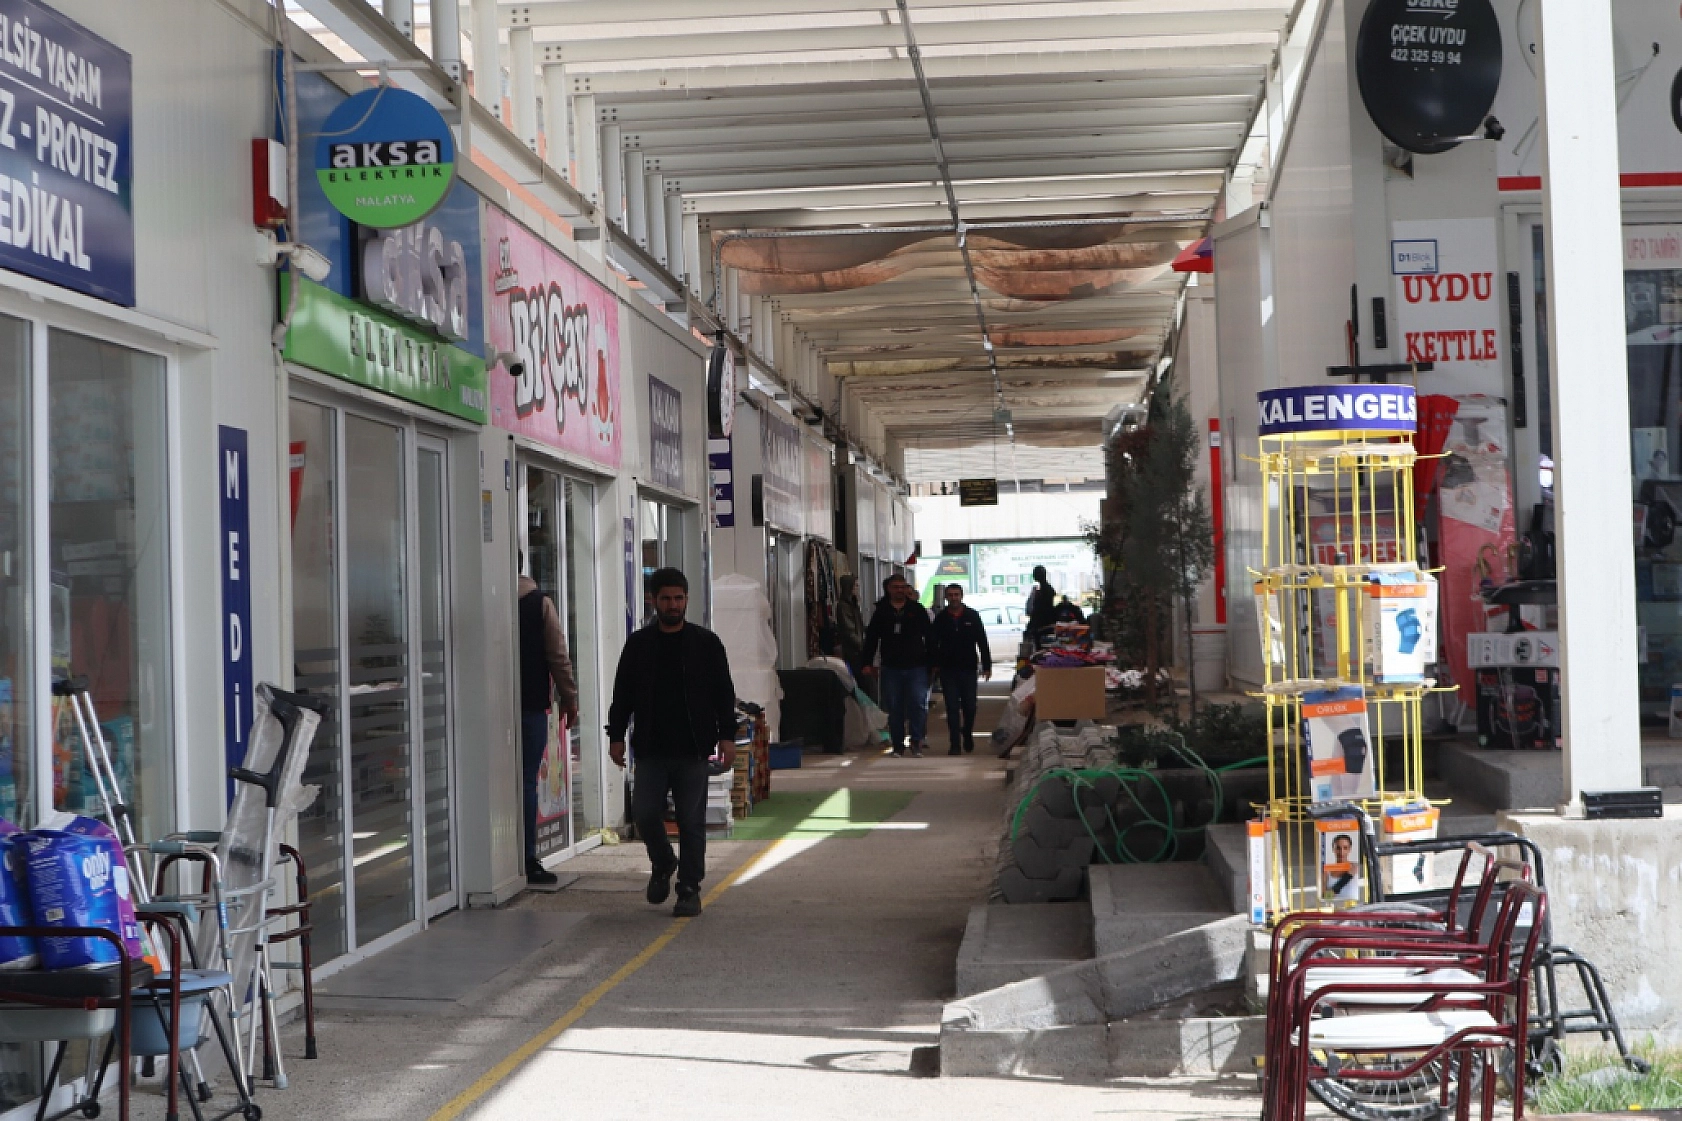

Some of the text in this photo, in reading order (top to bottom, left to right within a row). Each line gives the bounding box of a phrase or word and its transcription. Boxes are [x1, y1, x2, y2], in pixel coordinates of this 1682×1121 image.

[1429, 26, 1466, 46] UYDU
[1391, 48, 1461, 64] 422 325 59 94
[46, 38, 101, 109] YAŞAM
[36, 104, 118, 194] PROTEZ
[332, 141, 438, 168] aksa
[329, 166, 442, 182] ELEKTRİK
[356, 194, 416, 207] MALATYA
[1626, 237, 1647, 260] UFO
[1401, 272, 1493, 304] UYDU
[1404, 329, 1497, 362] KETTLE
